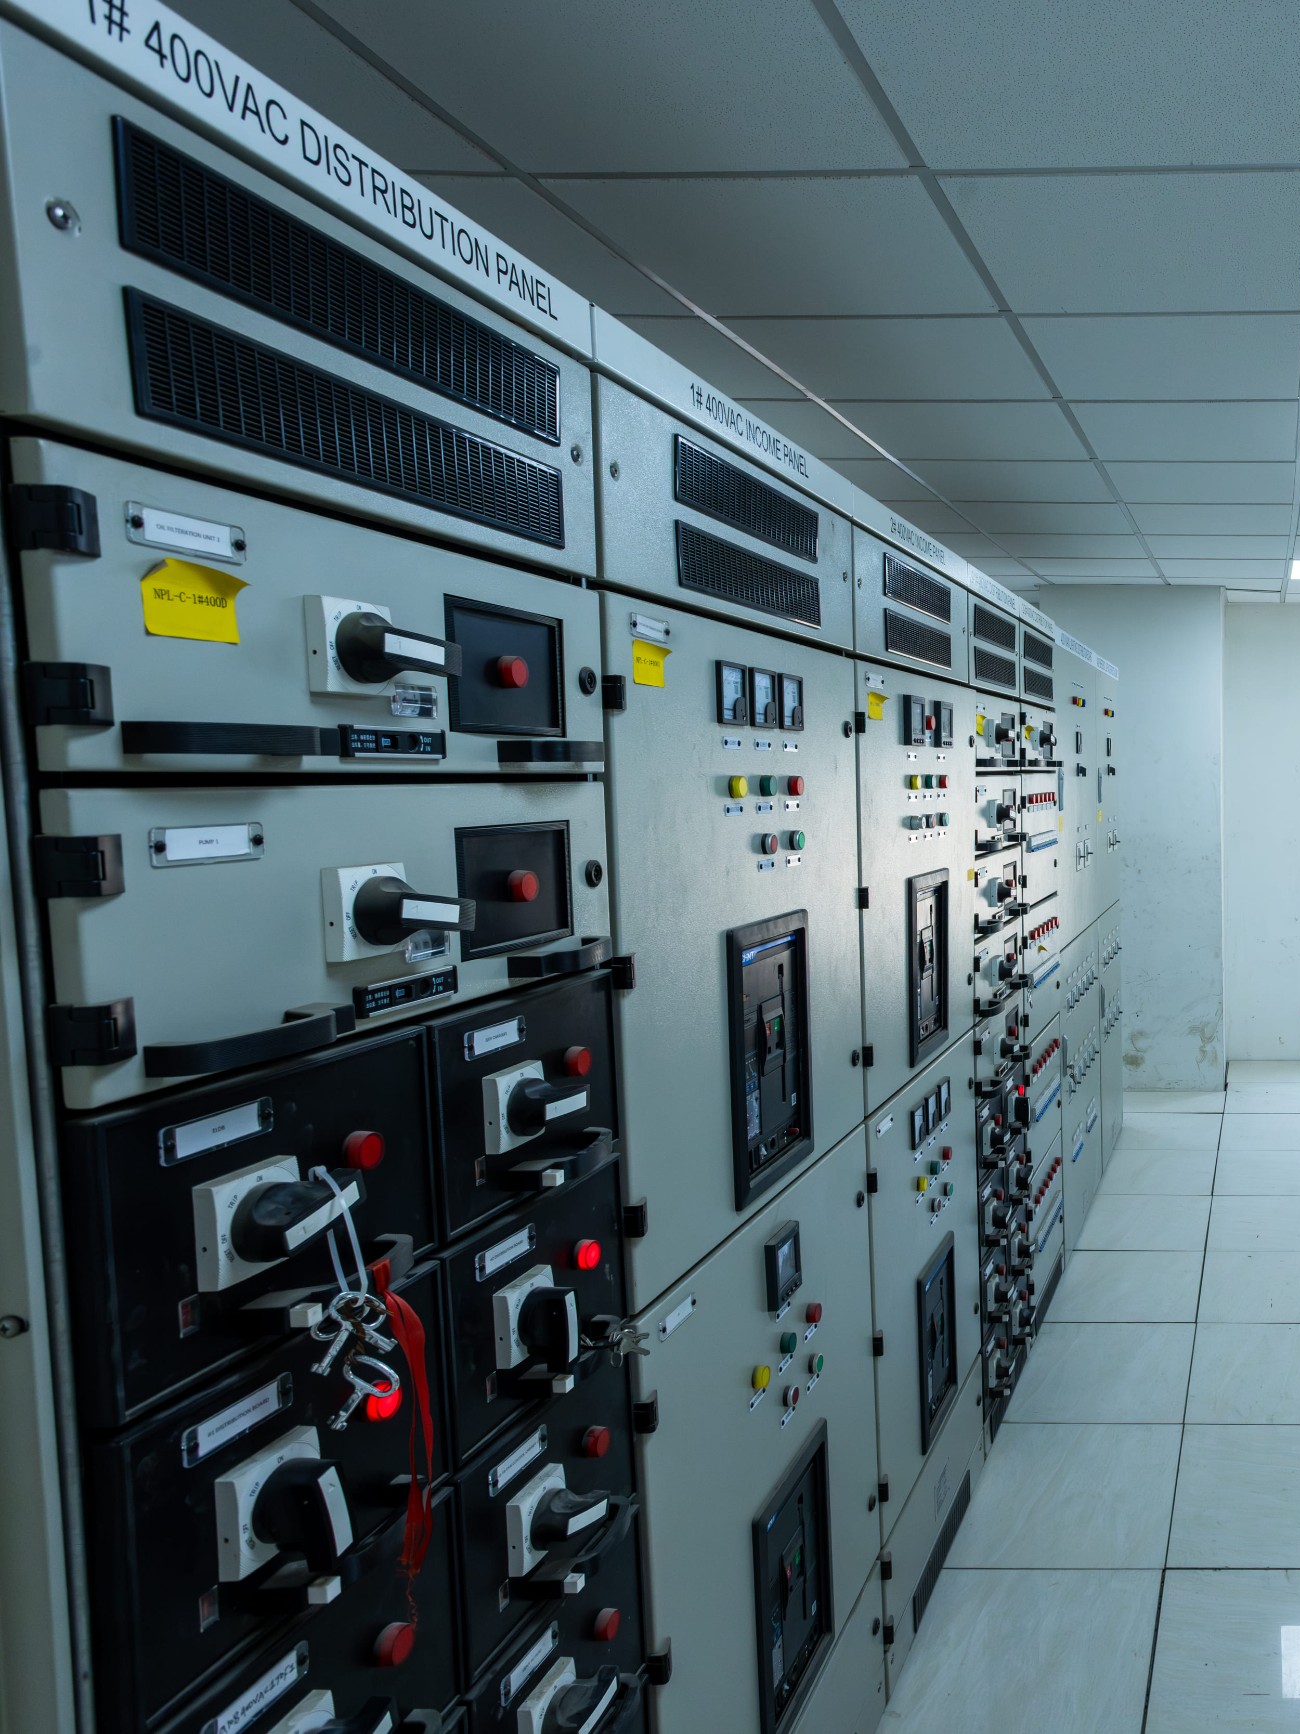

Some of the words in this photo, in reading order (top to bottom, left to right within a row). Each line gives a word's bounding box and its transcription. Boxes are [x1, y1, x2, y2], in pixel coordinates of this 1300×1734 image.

[144, 20, 289, 146] 400VAC
[300, 118, 490, 278] DISTRIBUTION
[496, 251, 558, 321] PANEL
[690, 382, 703, 411] 1#
[706, 393, 744, 437] 400VAC
[745, 418, 782, 461] INCOME
[783, 443, 809, 479] PANEL
[932, 544, 946, 566] PANEL
[152, 587, 228, 609] NPL-C-1#400D
[227, 1194, 239, 1210] TRIP
[249, 1481, 261, 1498] TRIP
